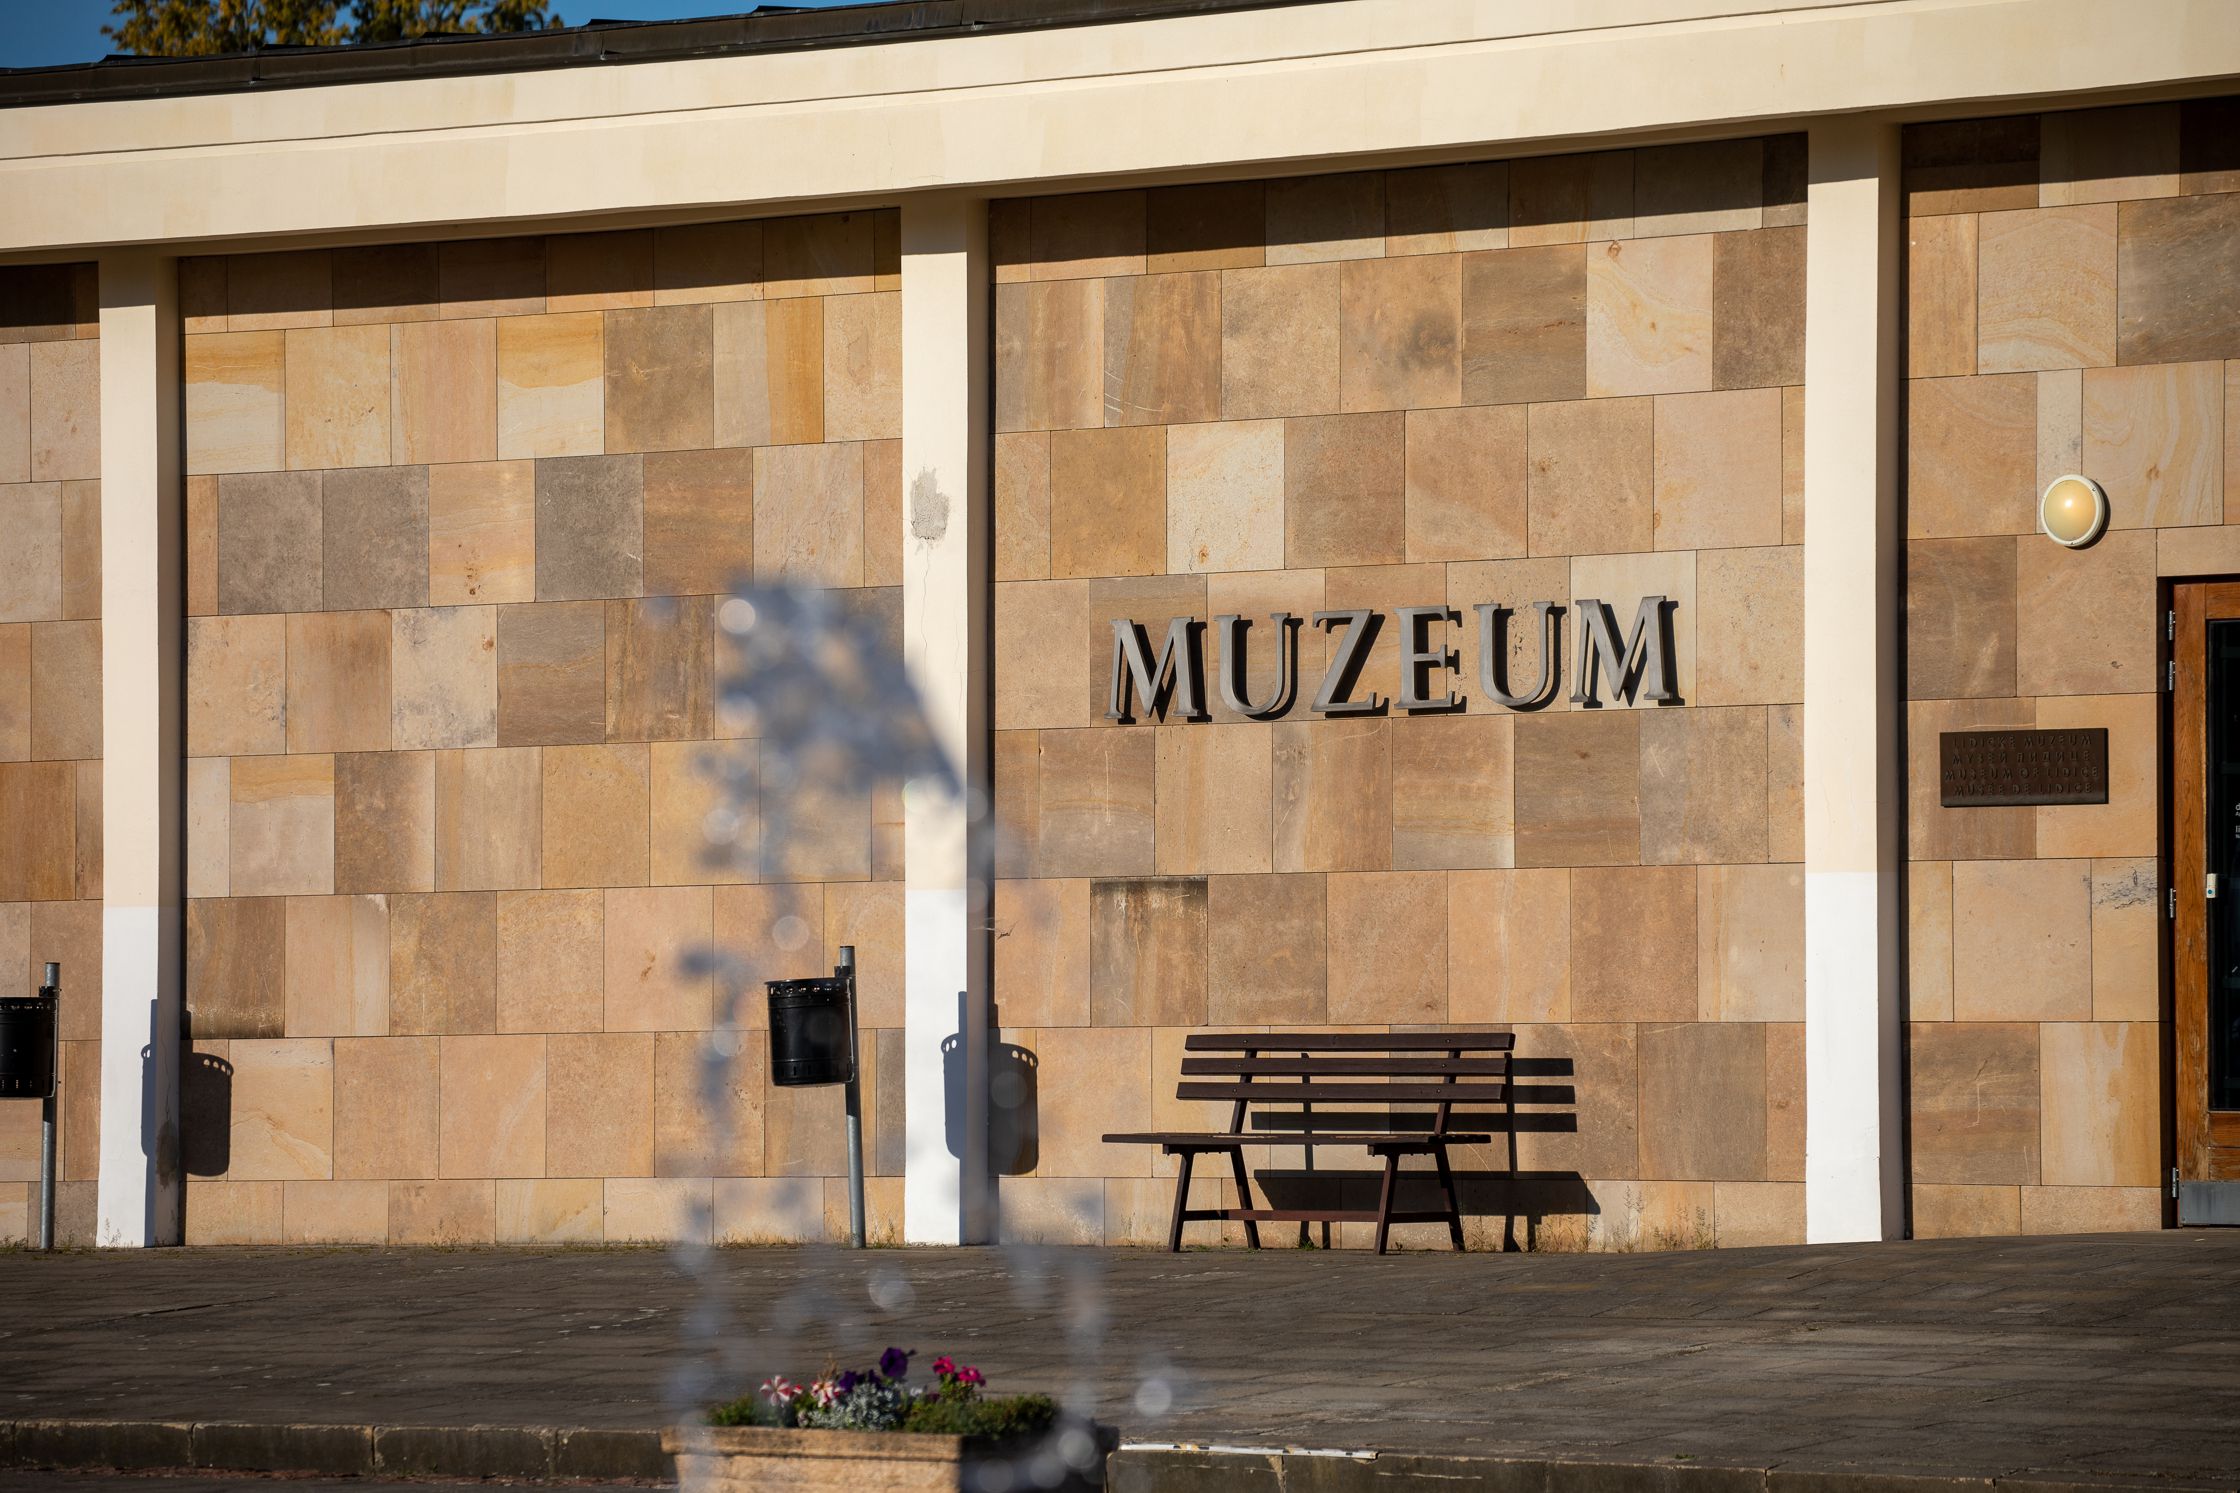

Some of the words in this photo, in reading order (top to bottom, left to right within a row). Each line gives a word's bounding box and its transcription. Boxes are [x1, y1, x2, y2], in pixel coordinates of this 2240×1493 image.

[1103, 595, 1673, 720] MUZEUM
[2023, 734, 2092, 748] MUZEUM
[1944, 767, 2013, 781] MUSEUM
[2019, 767, 2040, 779] OF
[2046, 766, 2099, 779] LIDICE
[2012, 782, 2032, 796] DE
[2038, 781, 2093, 795] LIDICE
